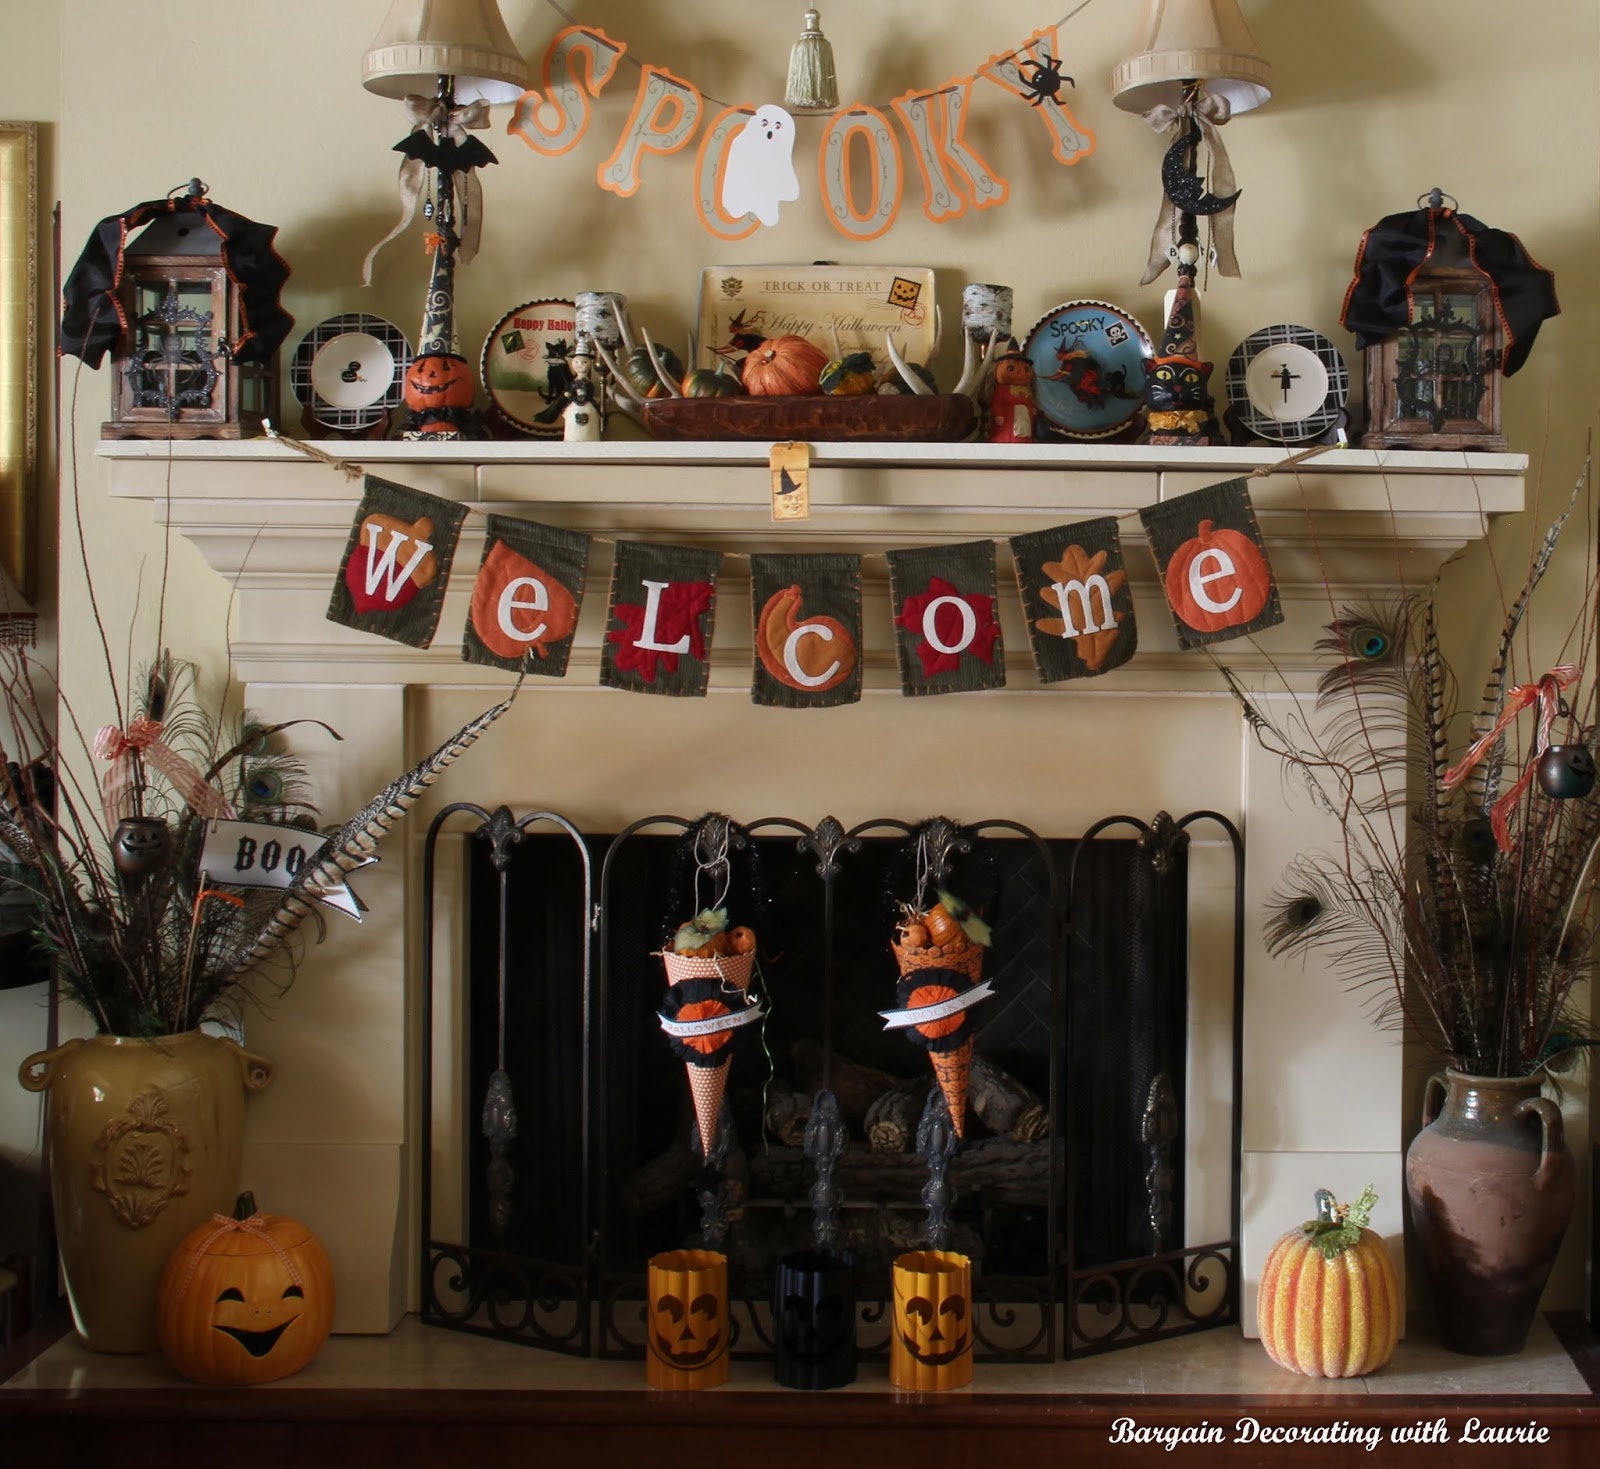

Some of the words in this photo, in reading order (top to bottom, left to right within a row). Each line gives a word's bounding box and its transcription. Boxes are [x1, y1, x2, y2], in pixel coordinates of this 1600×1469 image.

[763, 281, 805, 291] TRICK
[812, 281, 831, 292] OR
[837, 281, 882, 292] TREAT
[513, 317, 545, 332] Happy
[760, 312, 814, 338] Happy
[819, 311, 902, 333] Halloween
[1050, 316, 1106, 338] SPOOKY
[233, 835, 307, 877] BOO
[905, 997, 968, 1021] SPOOKY
[667, 1016, 743, 1034] HALLOWEEN
